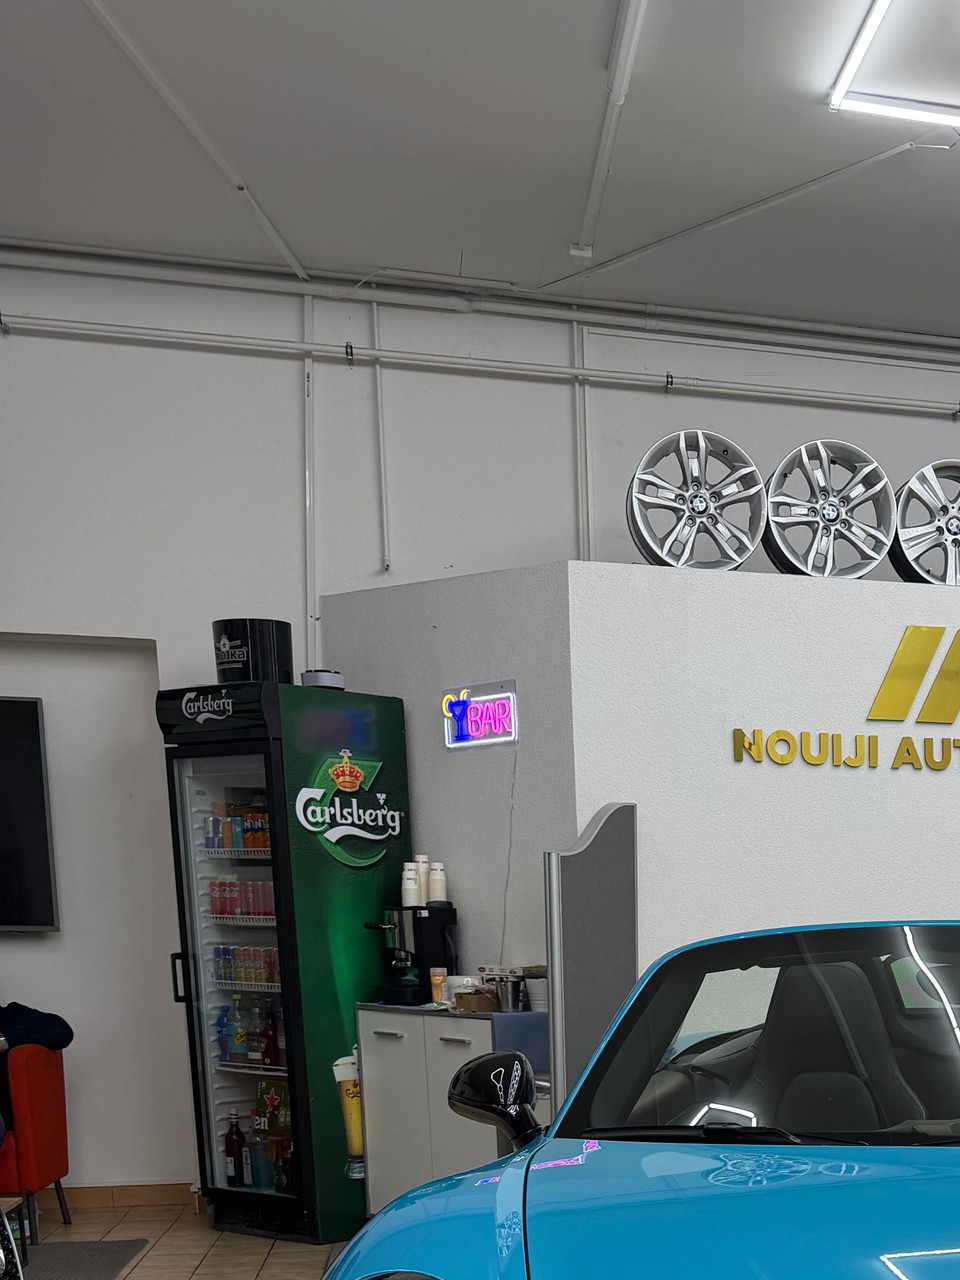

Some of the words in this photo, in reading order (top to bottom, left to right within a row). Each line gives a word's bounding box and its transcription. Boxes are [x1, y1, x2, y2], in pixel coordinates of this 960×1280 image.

[182, 691, 233, 722] Carlsberg
[467, 699, 512, 737] BAR
[732, 728, 879, 768] NOUIJI
[295, 787, 402, 840] Carlsberg
